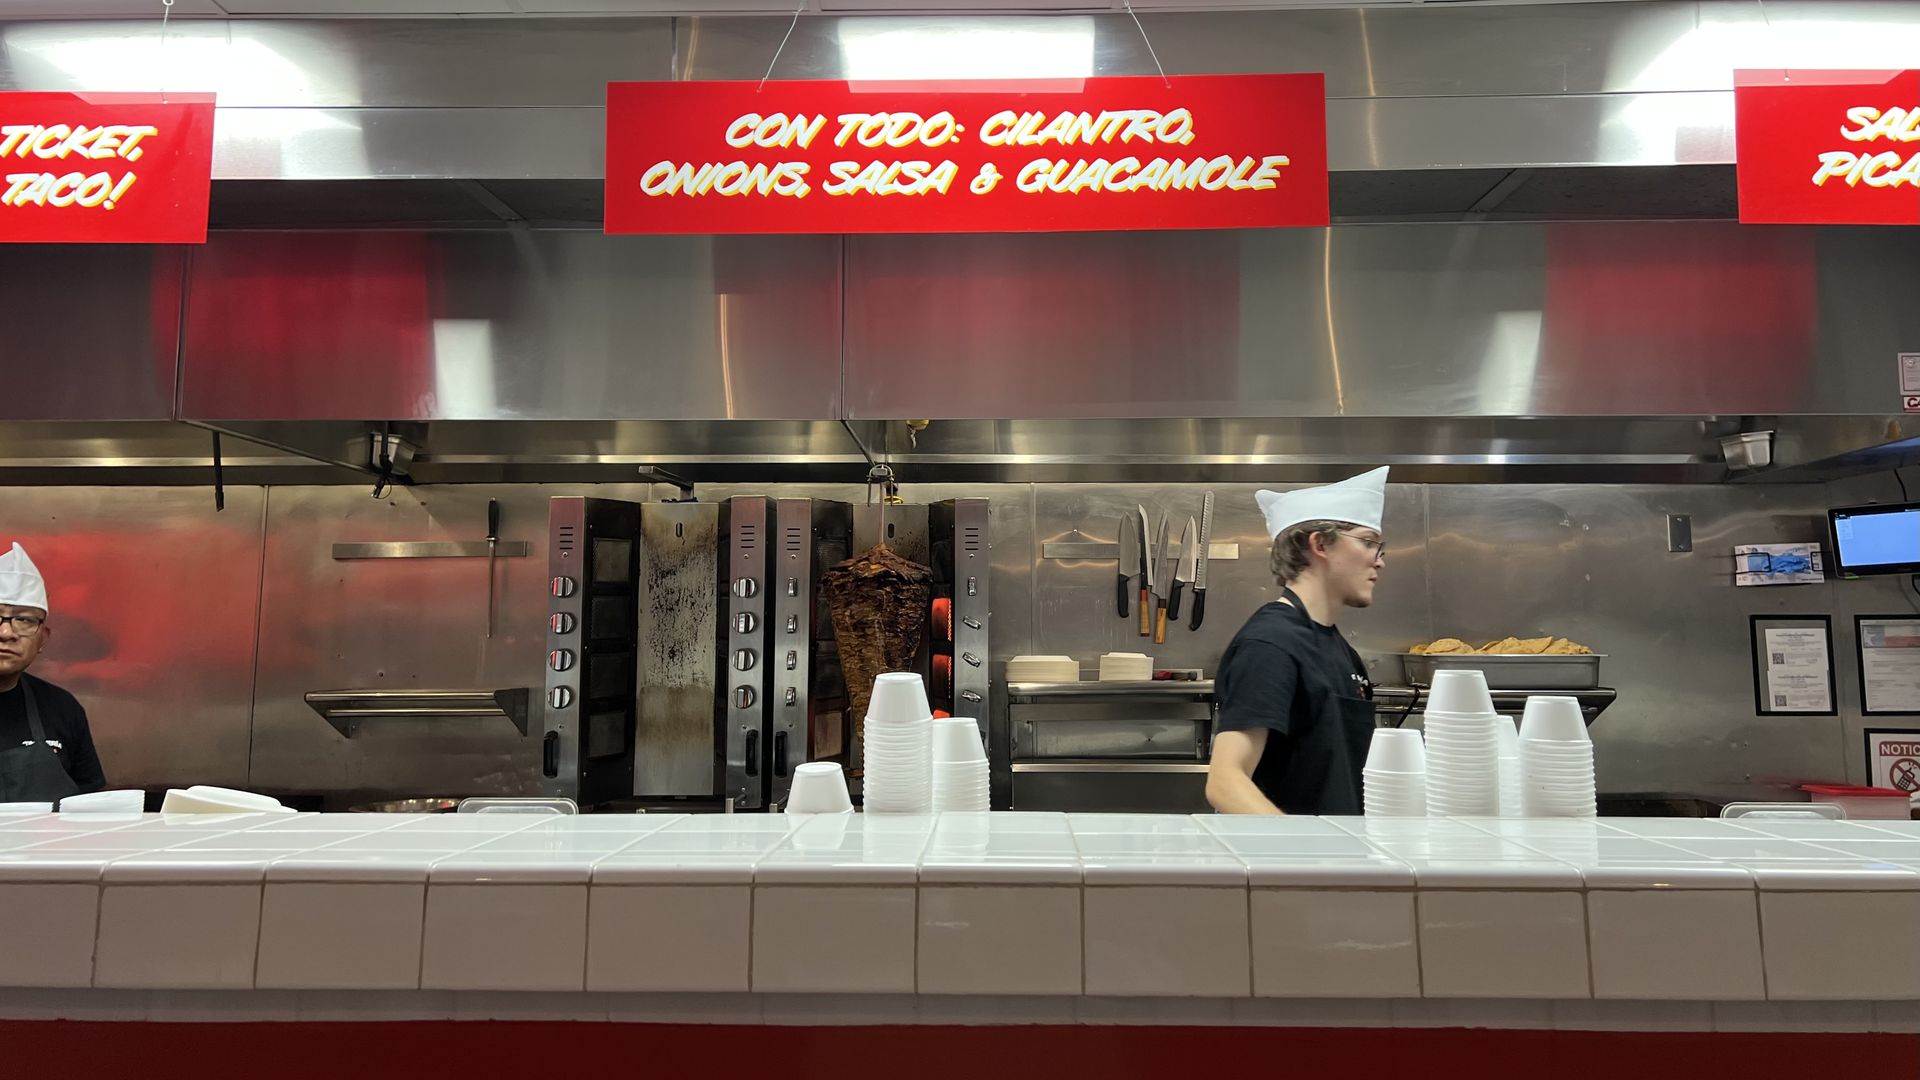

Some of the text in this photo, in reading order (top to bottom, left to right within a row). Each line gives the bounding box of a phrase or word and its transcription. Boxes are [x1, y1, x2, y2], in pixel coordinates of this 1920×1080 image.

[0, 123, 159, 162] TICKET,
[725, 107, 1196, 150] CON TODO: CILANTRO,
[0, 171, 137, 210] TACO!
[639, 154, 1290, 199] ONIONS, SALSA & GUACAMOLE
